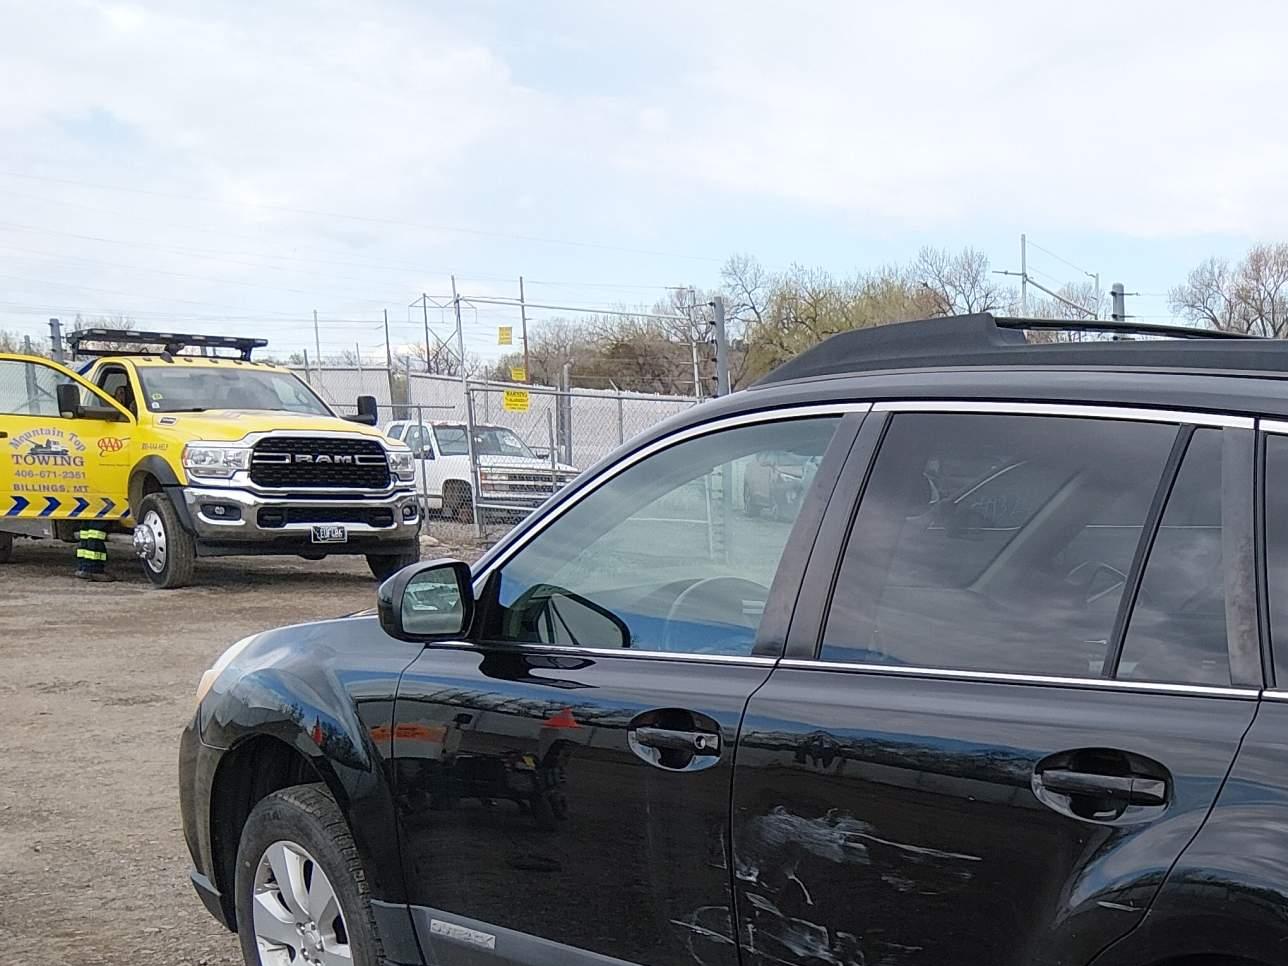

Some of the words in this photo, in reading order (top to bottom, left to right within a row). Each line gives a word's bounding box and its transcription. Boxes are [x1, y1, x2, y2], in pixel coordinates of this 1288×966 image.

[9, 427, 64, 449] Mountain
[69, 432, 87, 452] Top
[12, 454, 84, 467] TOWING
[295, 454, 352, 464] RAM
[73, 485, 89, 493] MT
